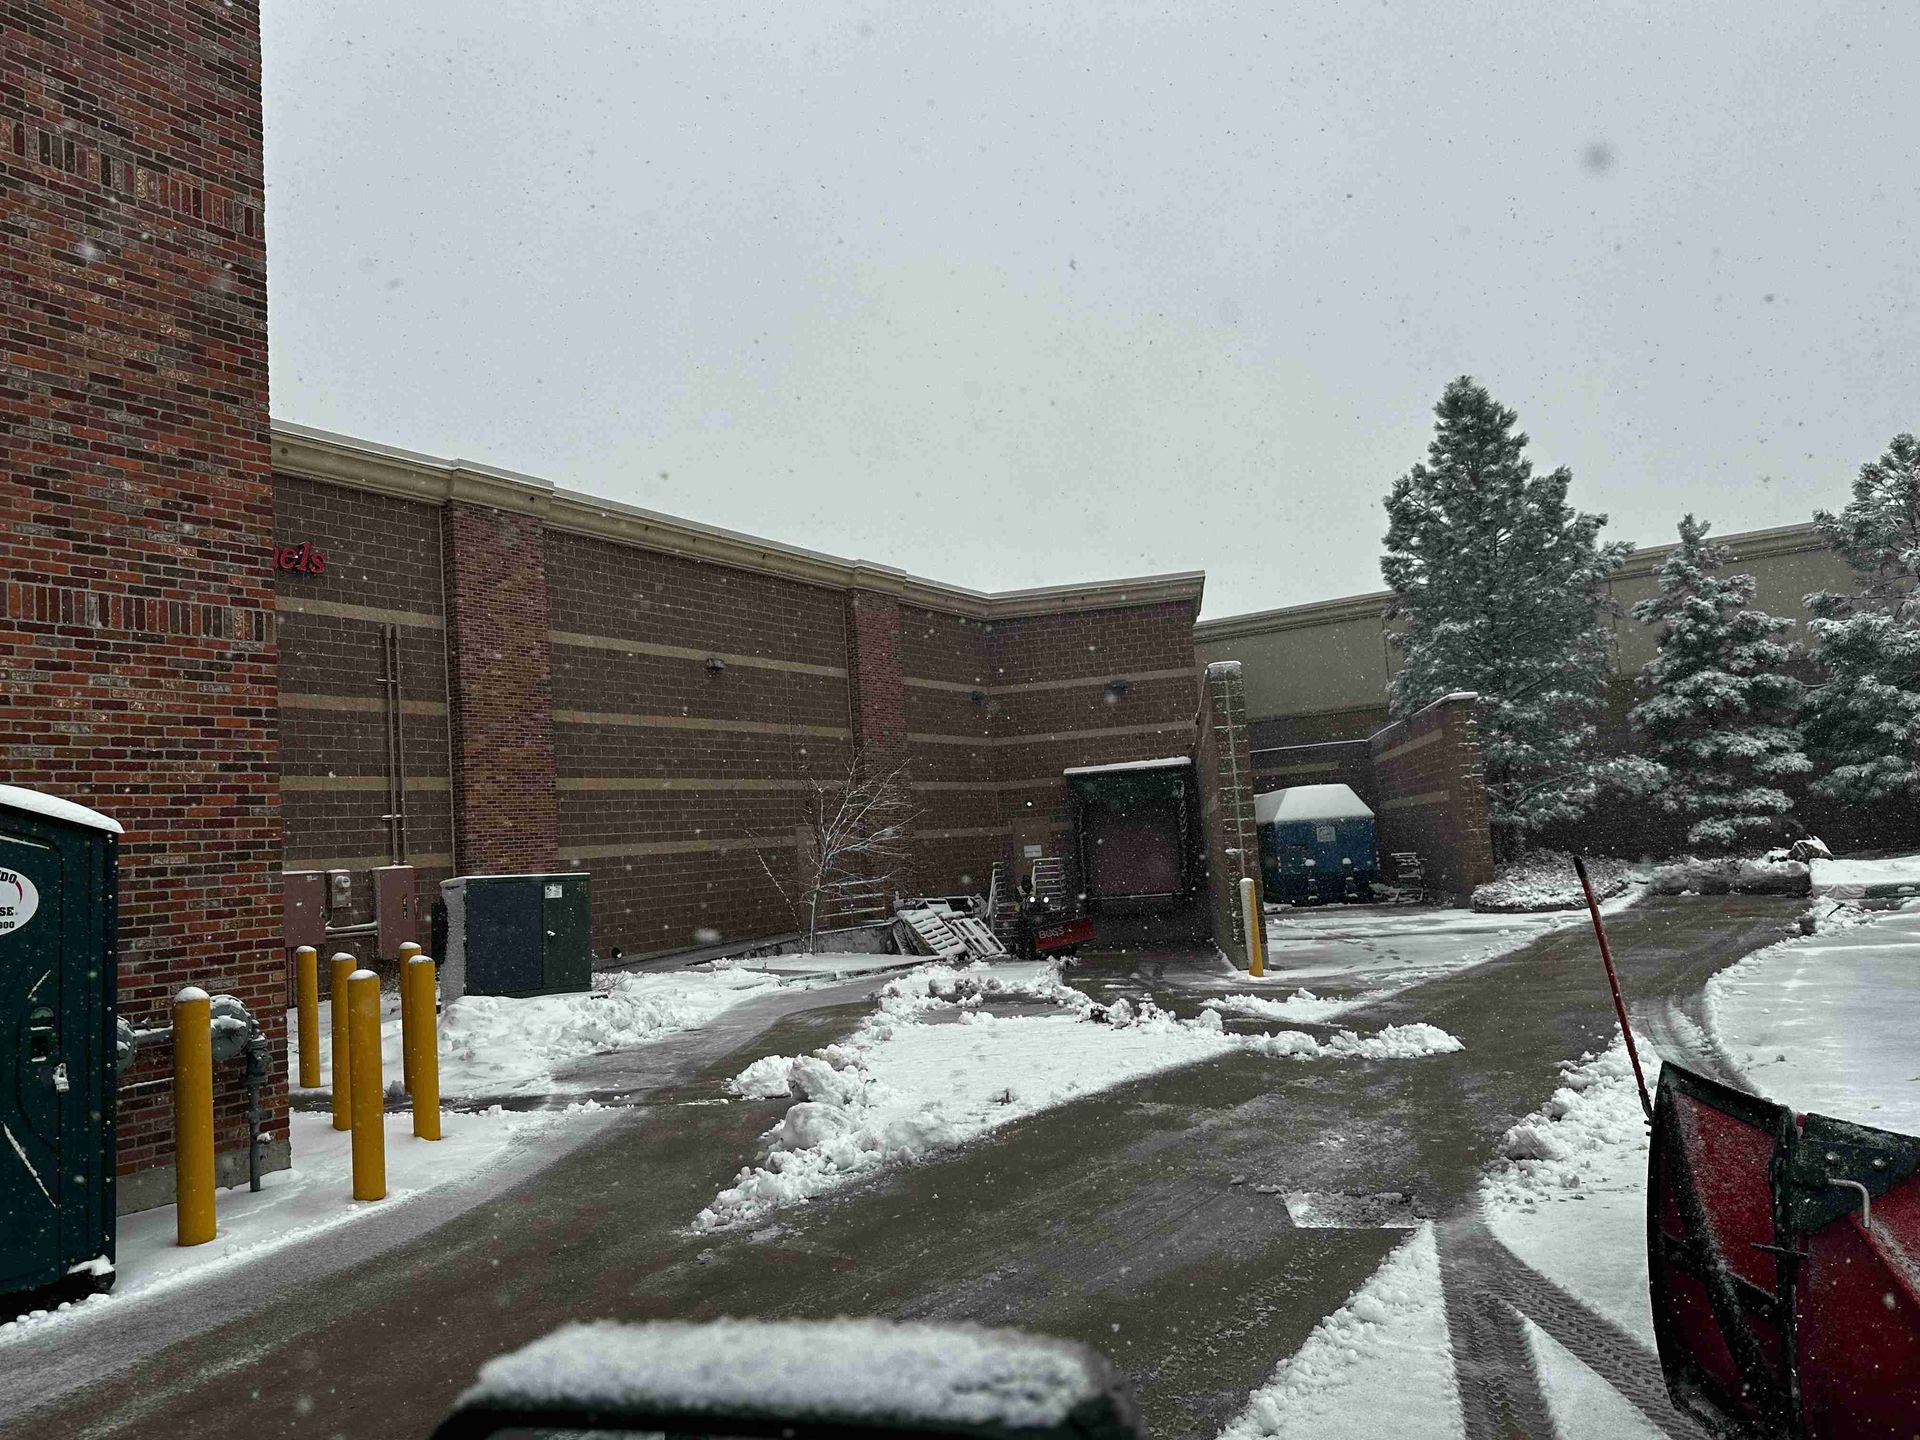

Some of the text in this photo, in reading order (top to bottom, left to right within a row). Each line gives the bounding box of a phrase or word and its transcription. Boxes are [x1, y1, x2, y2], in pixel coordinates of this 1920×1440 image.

[0, 870, 17, 884] DO
[0, 906, 14, 916] SE
[1039, 926, 1064, 939] BOSS
